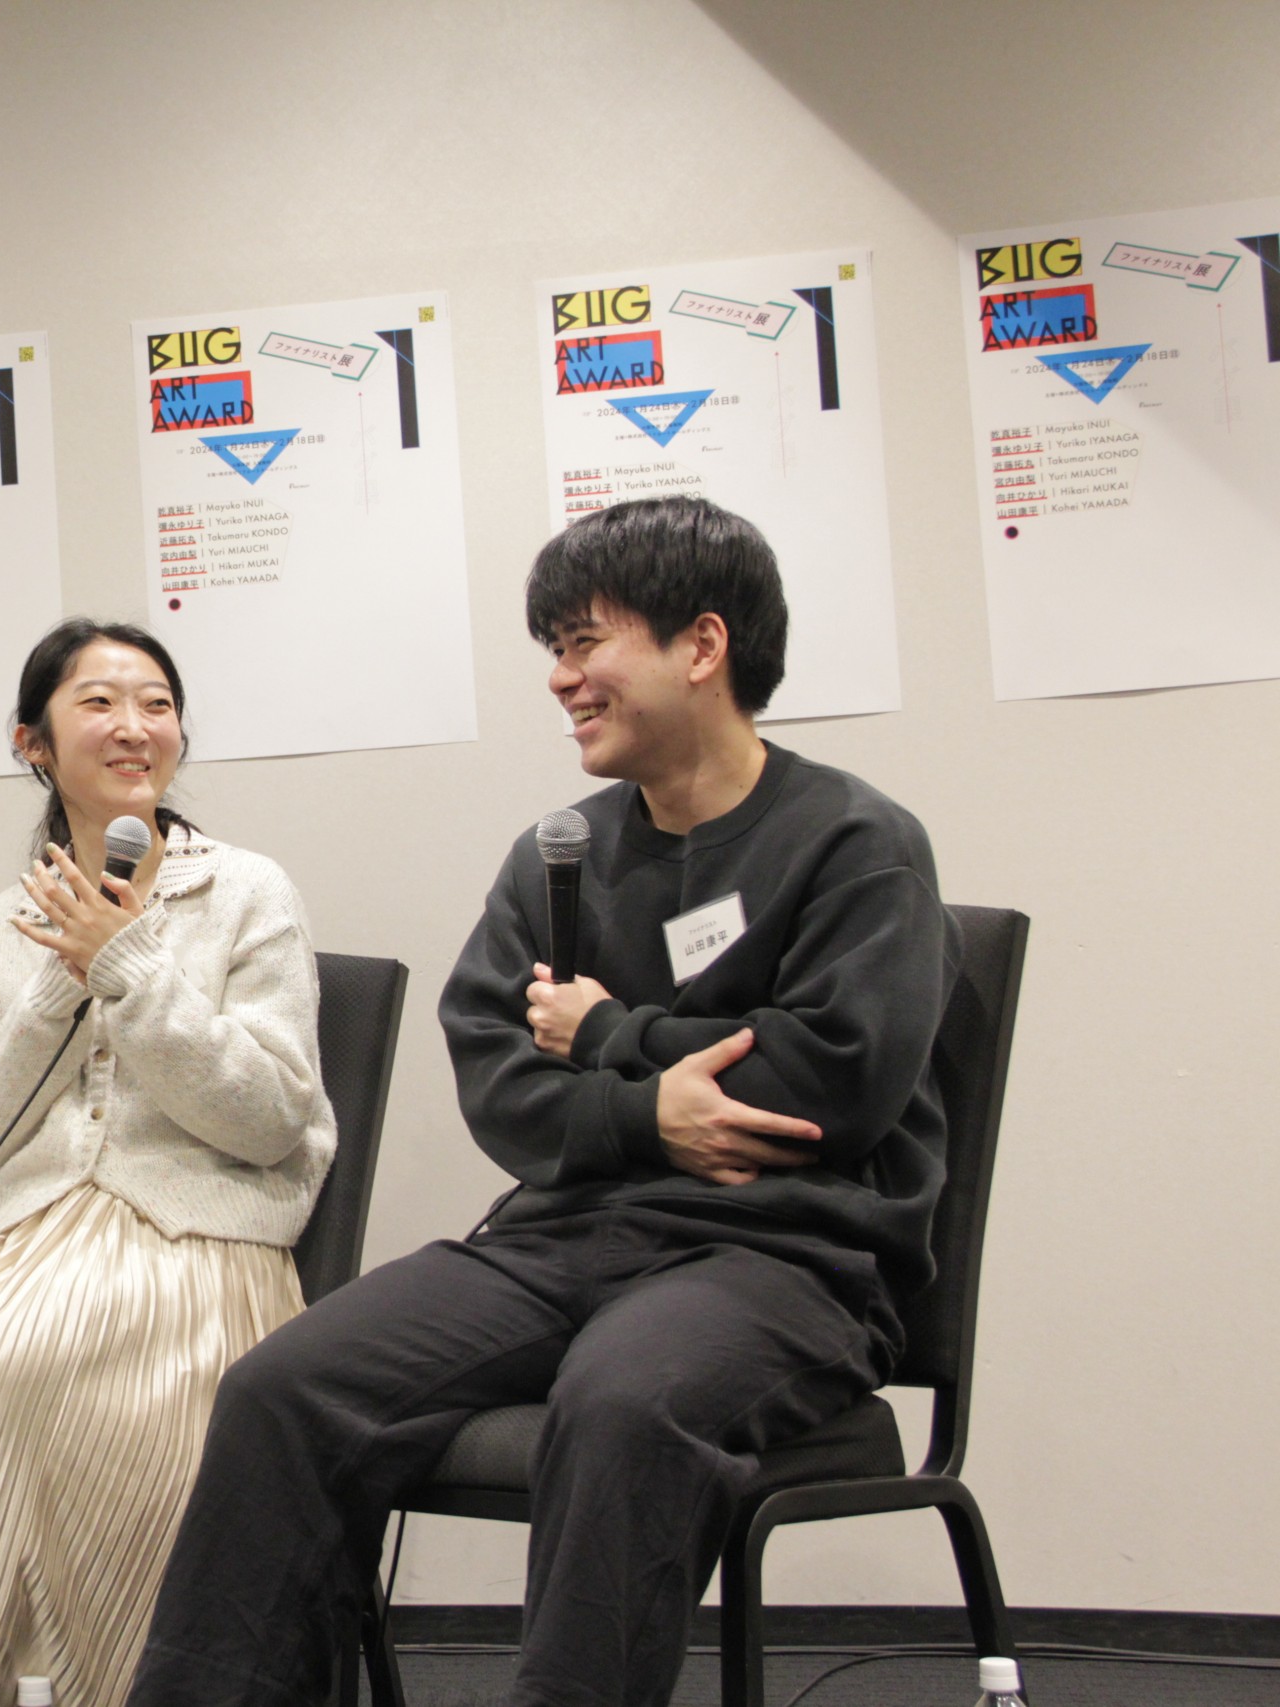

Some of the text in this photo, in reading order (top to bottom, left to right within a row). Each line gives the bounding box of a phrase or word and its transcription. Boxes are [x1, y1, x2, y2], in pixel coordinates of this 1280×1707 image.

[976, 238, 1083, 291] BUG
[1120, 252, 1211, 276] ファイナリスト展
[552, 285, 652, 335] BUG
[686, 300, 770, 326] ファイナリスト展
[980, 290, 1035, 321] ART
[982, 314, 1097, 353] AWARD
[148, 327, 242, 374] BUG
[275, 342, 354, 367] ファイナリスト展
[555, 335, 607, 365] ART
[556, 360, 664, 395] AWARD
[150, 375, 199, 403] ART
[151, 399, 254, 433] AWARD
[1087, 419, 1110, 429] INUI
[1090, 432, 1139, 445] IYANAGA
[1097, 448, 1139, 461] KONDO
[614, 465, 651, 477] Mayuko
[654, 462, 675, 472] INUI
[1070, 467, 1117, 479] MIAUCHI
[624, 480, 653, 490] Yuriko
[656, 475, 702, 487] IYANAGA
[1093, 481, 1129, 493] MUKAI
[206, 501, 241, 513] Mayuko
[243, 499, 264, 508] INUI
[1081, 497, 1128, 510] YAMADA
[215, 516, 243, 526] Yuriko
[245, 511, 289, 523] IYANAGA
[208, 530, 249, 542] Takumaru
[252, 526, 288, 538] KONDO
[209, 547, 225, 556] Yuri
[228, 543, 269, 555] MIAUCHI
[219, 561, 244, 571] Hikari
[247, 558, 279, 568] MUKAI
[210, 577, 235, 587] Kohei
[237, 573, 278, 584] YAMADA
[685, 930, 728, 956] 山田康平
